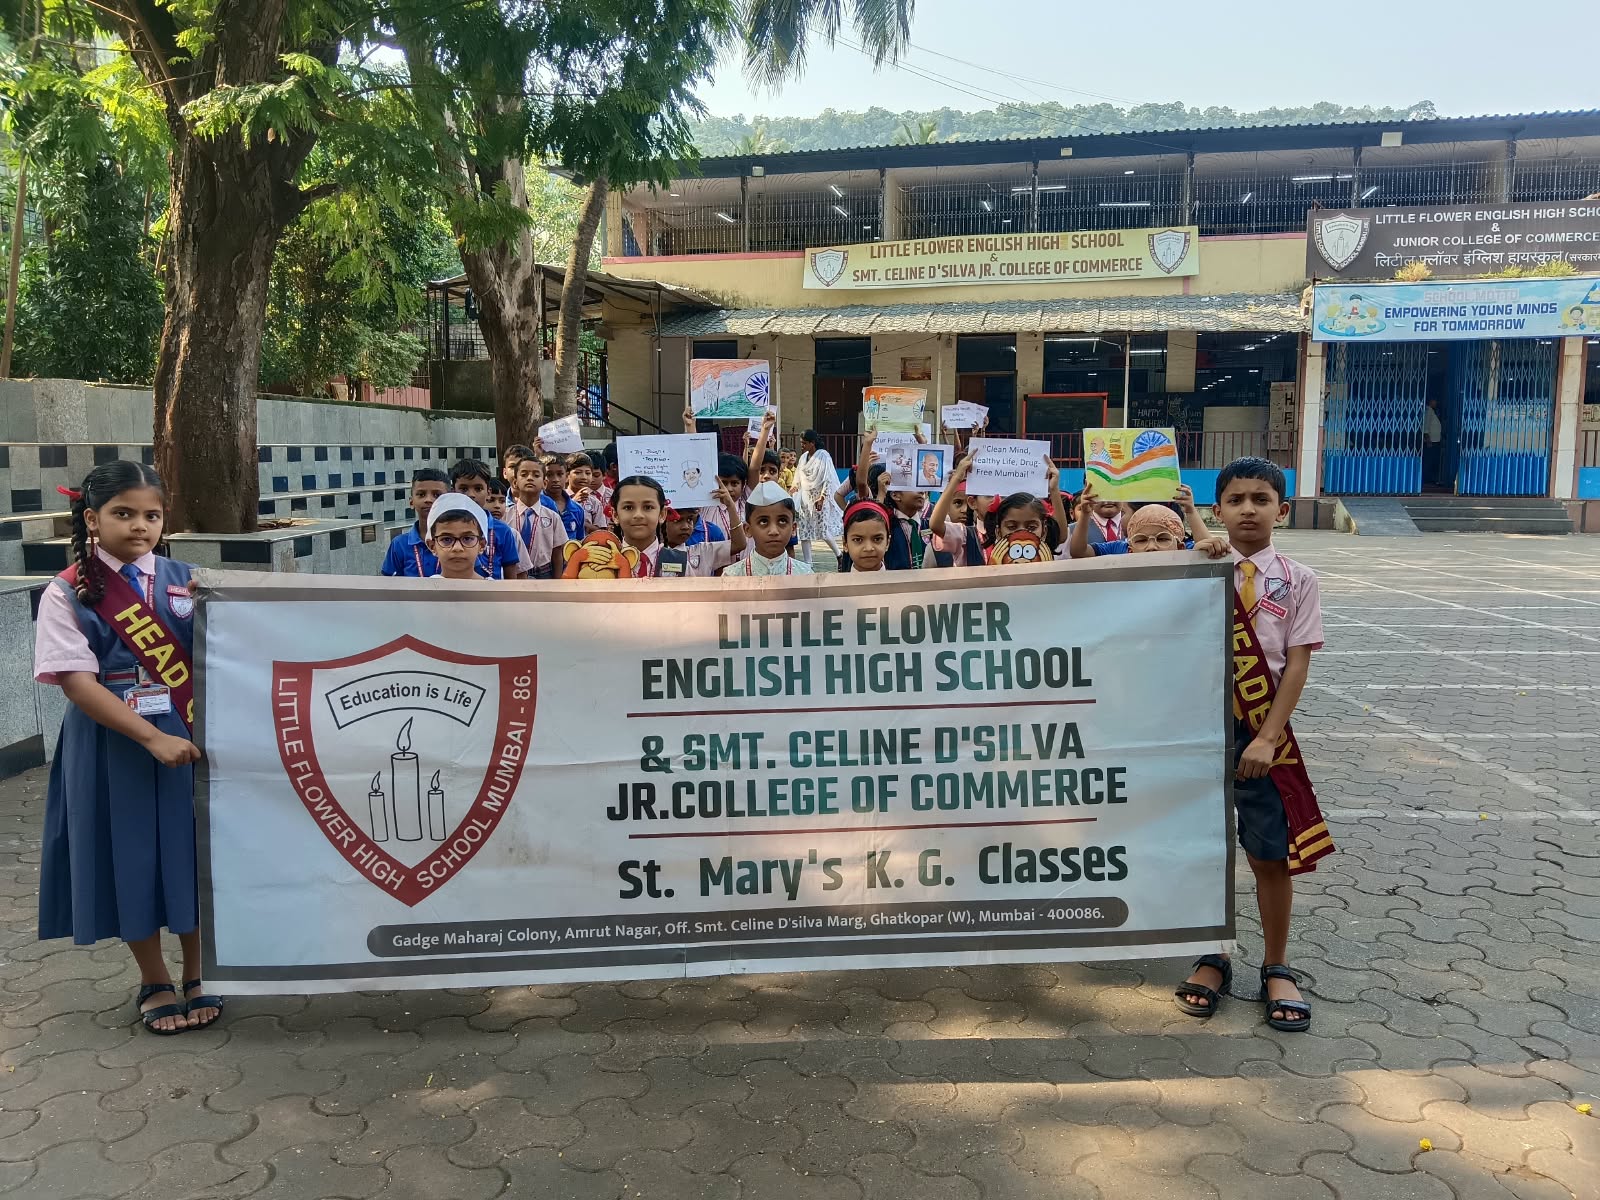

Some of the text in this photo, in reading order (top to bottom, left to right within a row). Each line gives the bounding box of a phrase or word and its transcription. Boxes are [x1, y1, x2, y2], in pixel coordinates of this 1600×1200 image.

[1375, 213, 1416, 224] LITTLE
[1419, 212, 1472, 223] FLOWER
[1475, 209, 1530, 221] ENGLISH
[1534, 208, 1565, 219] HIGH
[1491, 222, 1500, 232] &
[870, 232, 1124, 259] LITTLE FLOWER ENGLISH HIGH SCHOOL
[990, 253, 998, 262] &
[1393, 232, 1600, 247] JUNIOR COLLEGE OF COMMERCE
[1463, 249, 1505, 266] इंग्लिश
[852, 258, 1142, 281] SMT. CELINE D'SILVA JR. COLLEGE OF COMMERCE
[1384, 302, 1558, 318] EMPOWERING YOUNG MINDS
[1414, 318, 1526, 332] FOR TOMMORROW
[1136, 408, 1161, 418] HAPPY
[1002, 458, 1018, 466] Life,
[1020, 459, 1041, 468] Drug-
[1009, 446, 1031, 455] Mind,
[718, 601, 1012, 649] LITTLE FLOWER
[114, 603, 189, 688] HEAD
[642, 647, 1092, 700] ENGLISH HIGH SCHOOL
[1233, 609, 1298, 767] EAD BY
[340, 683, 473, 711] Education is Life
[278, 677, 304, 756] LITTLE
[482, 721, 527, 813] MUMBAI
[513, 669, 532, 700] 86.
[641, 722, 1085, 773] & SMT. CELINE D'SILVA
[290, 760, 357, 849] FLOWER
[607, 767, 1127, 821] JR.COLLEGE OF COMMERCE
[352, 844, 405, 891] HIGH
[416, 818, 492, 889] SCHOOL
[618, 842, 1128, 901] St. Mary's K. G. Classes
[392, 933, 439, 950] Gadge
[443, 929, 503, 947] Maharaj
[507, 927, 561, 944] Colony,
[564, 925, 611, 940] Amrut
[615, 923, 661, 940] Nagar,
[664, 920, 691, 935] Off.
[695, 920, 728, 934] Smt.
[731, 917, 774, 931] Celine
[778, 914, 823, 930] D'silva
[827, 914, 867, 931] Marg,
[870, 909, 944, 929] Ghatkopar
[947, 909, 975, 926] (W),
[979, 907, 1036, 923] Mumbai
[1047, 906, 1105, 920] 400086.
